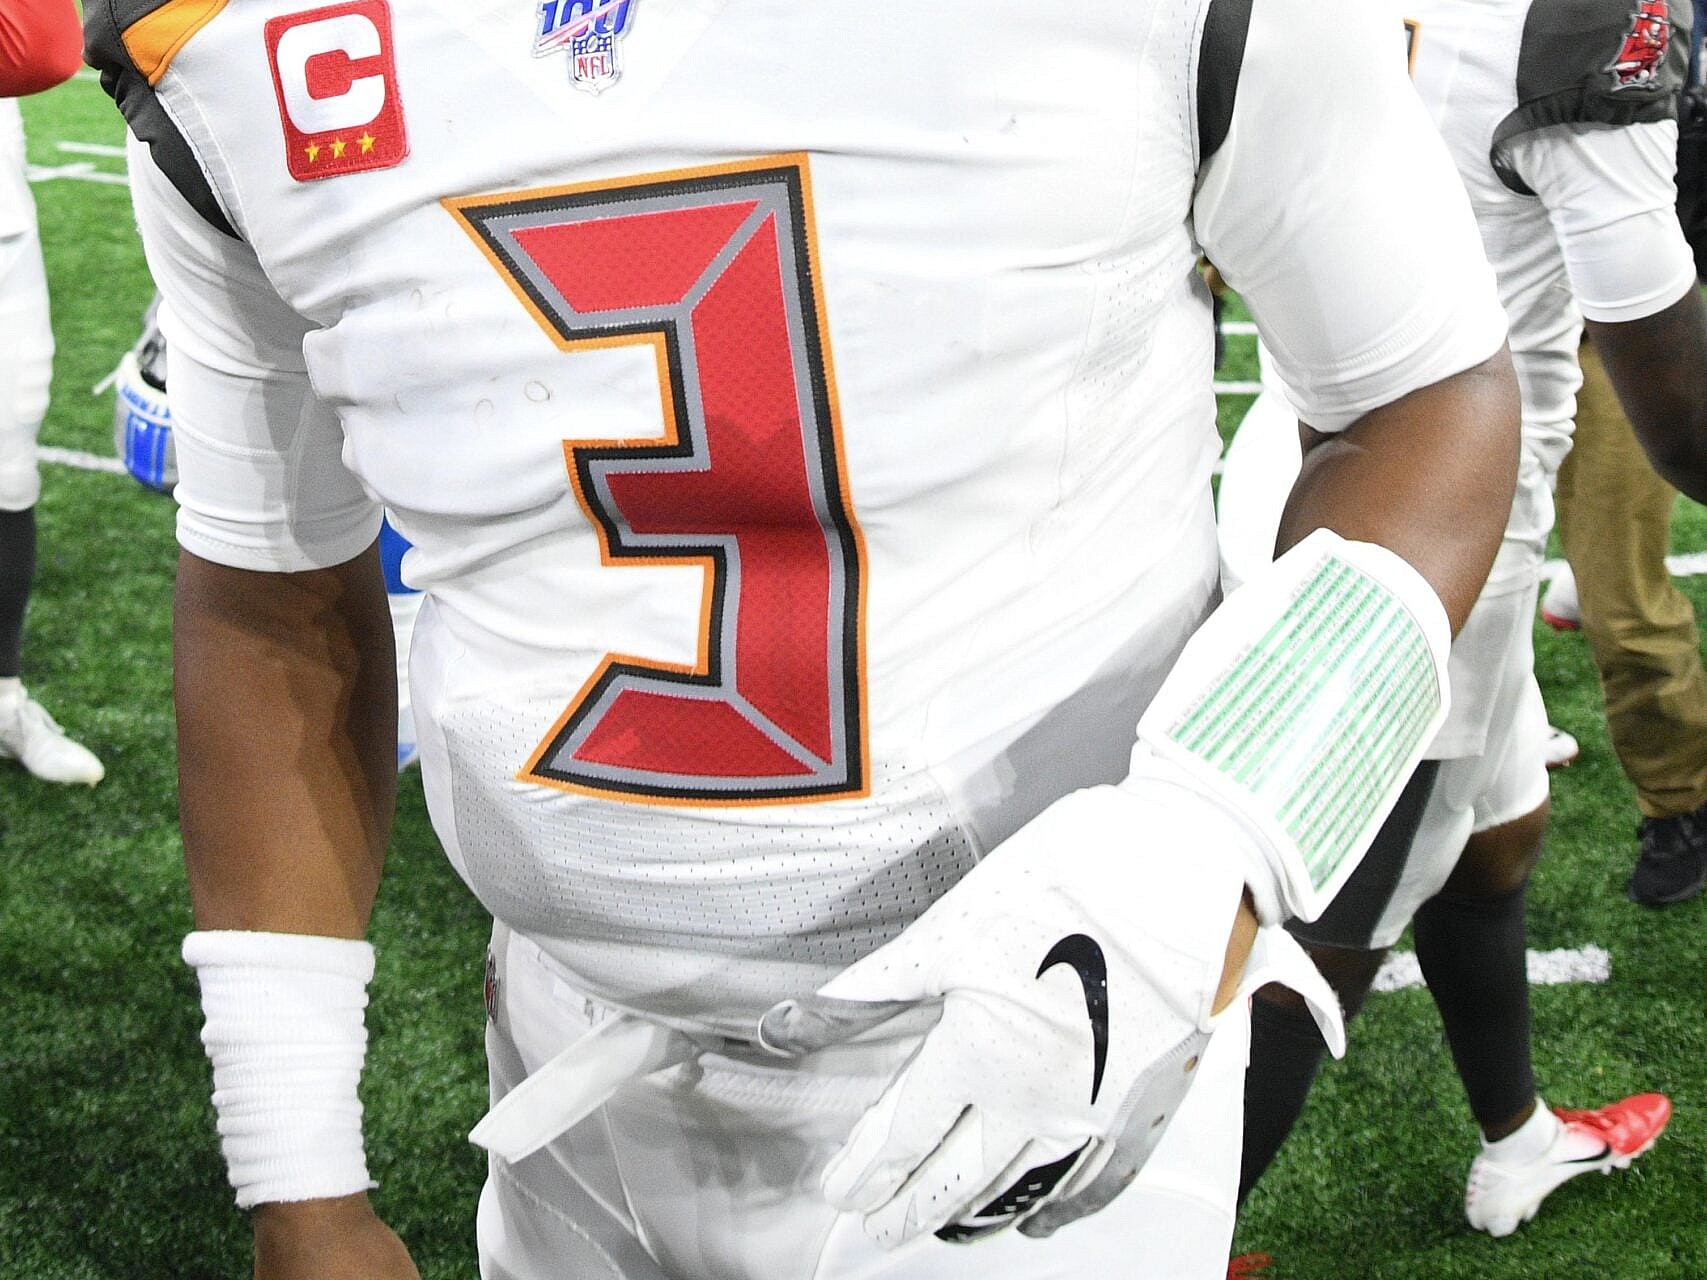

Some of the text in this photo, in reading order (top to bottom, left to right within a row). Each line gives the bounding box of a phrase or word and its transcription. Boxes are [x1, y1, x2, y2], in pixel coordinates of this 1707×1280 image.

[276, 13, 386, 135] C
[576, 55, 611, 80] NFL
[439, 151, 870, 808] 3
